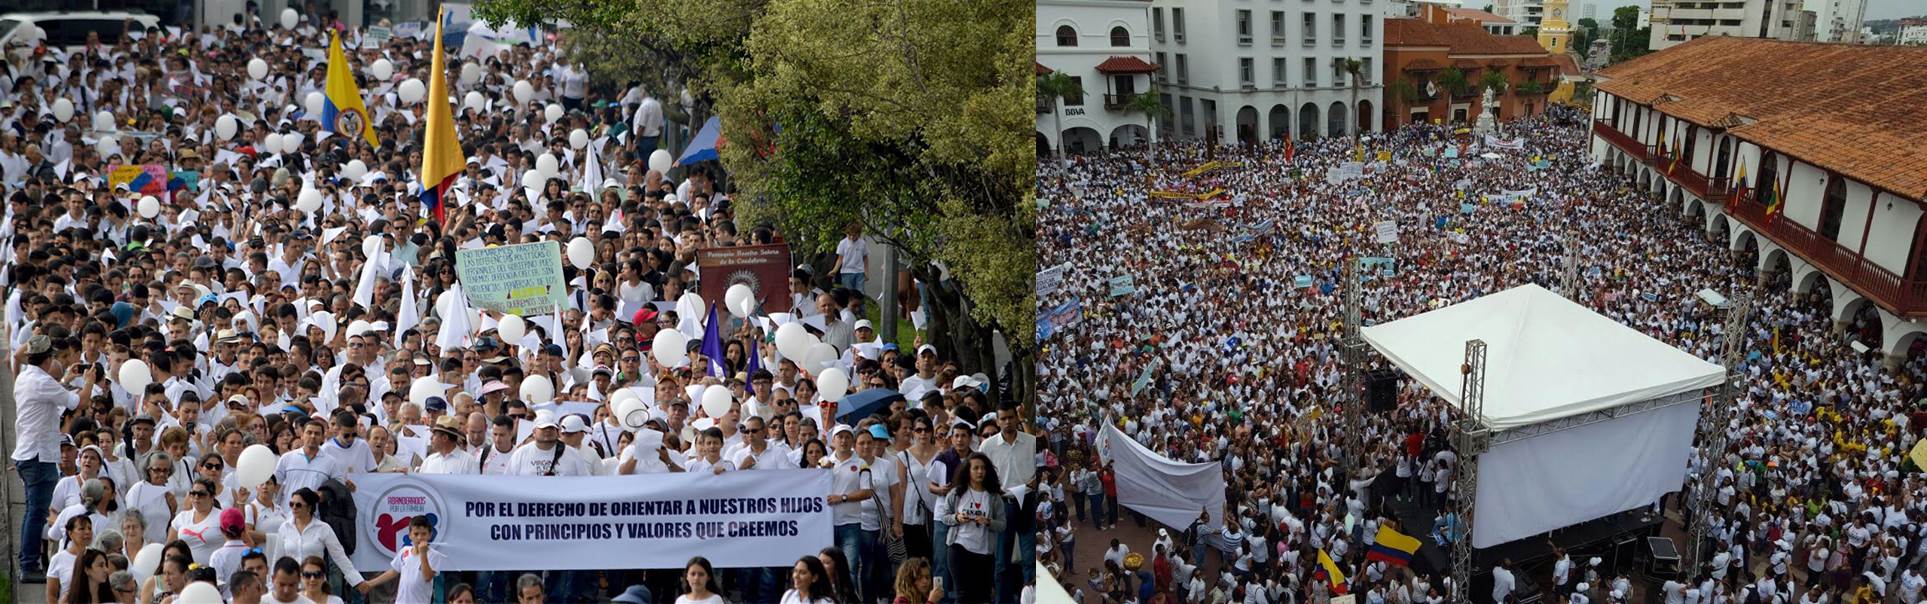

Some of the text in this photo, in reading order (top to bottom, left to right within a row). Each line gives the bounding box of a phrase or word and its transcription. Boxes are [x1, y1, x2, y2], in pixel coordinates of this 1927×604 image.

[465, 496, 823, 517] POR EL DERECHO DE ORIENTAR A NUESTROS HIJOS
[490, 519, 799, 541] CON PRINCIPIOS Y VALORES QUE CREEMOS
